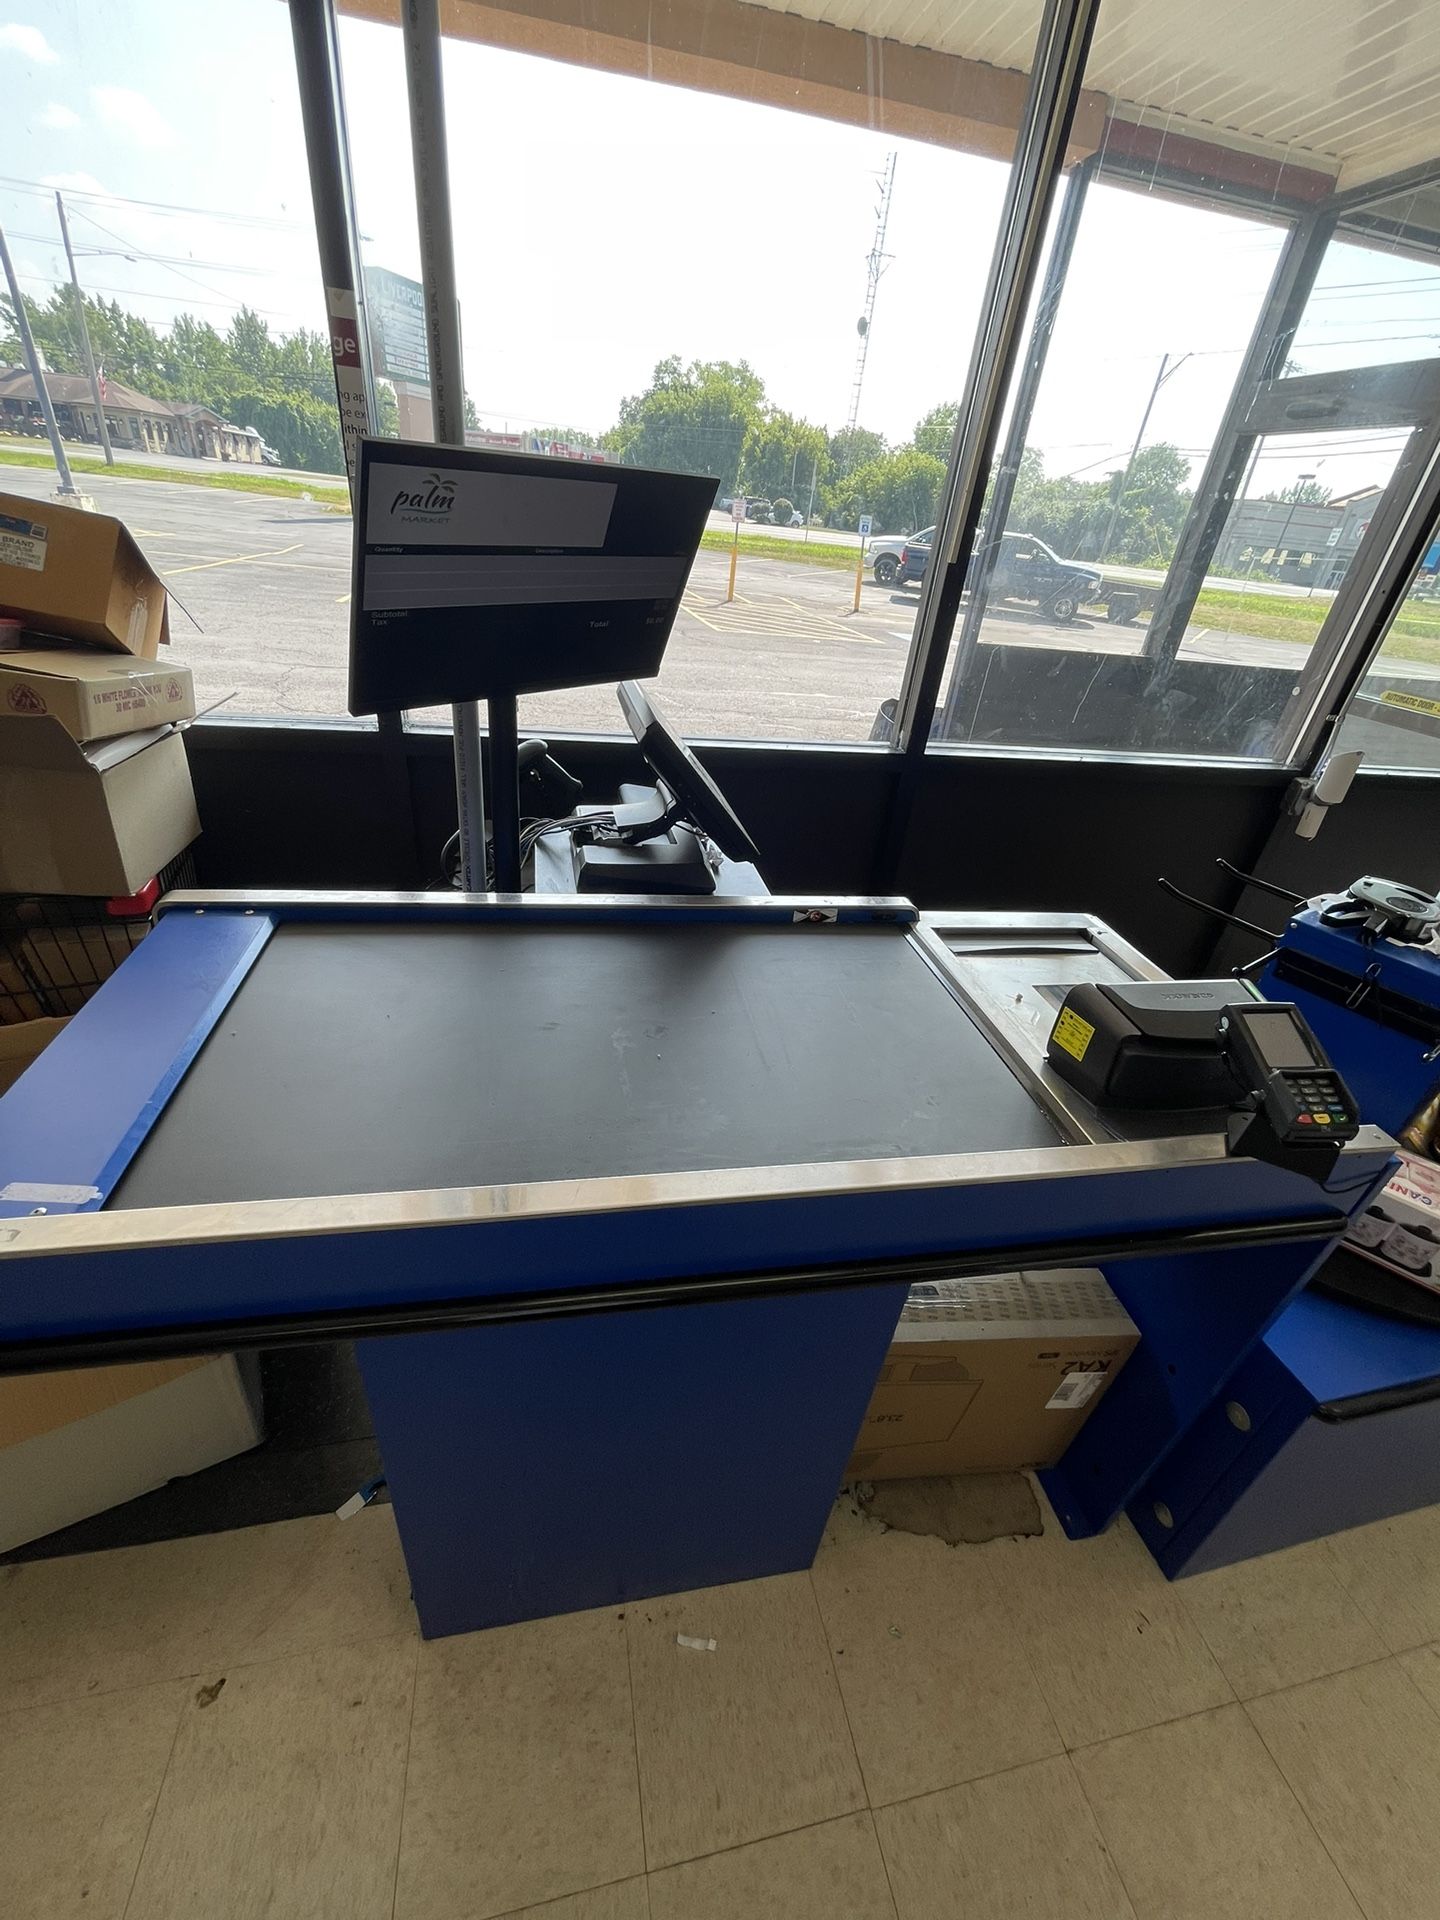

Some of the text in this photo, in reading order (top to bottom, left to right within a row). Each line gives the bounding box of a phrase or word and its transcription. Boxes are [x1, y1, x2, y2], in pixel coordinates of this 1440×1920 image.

[390, 485, 456, 515] palm
[400, 515, 451, 524] MARKET
[371, 610, 408, 619] Subtotal
[371, 618, 388, 626] Tax
[589, 620, 610, 628] Total
